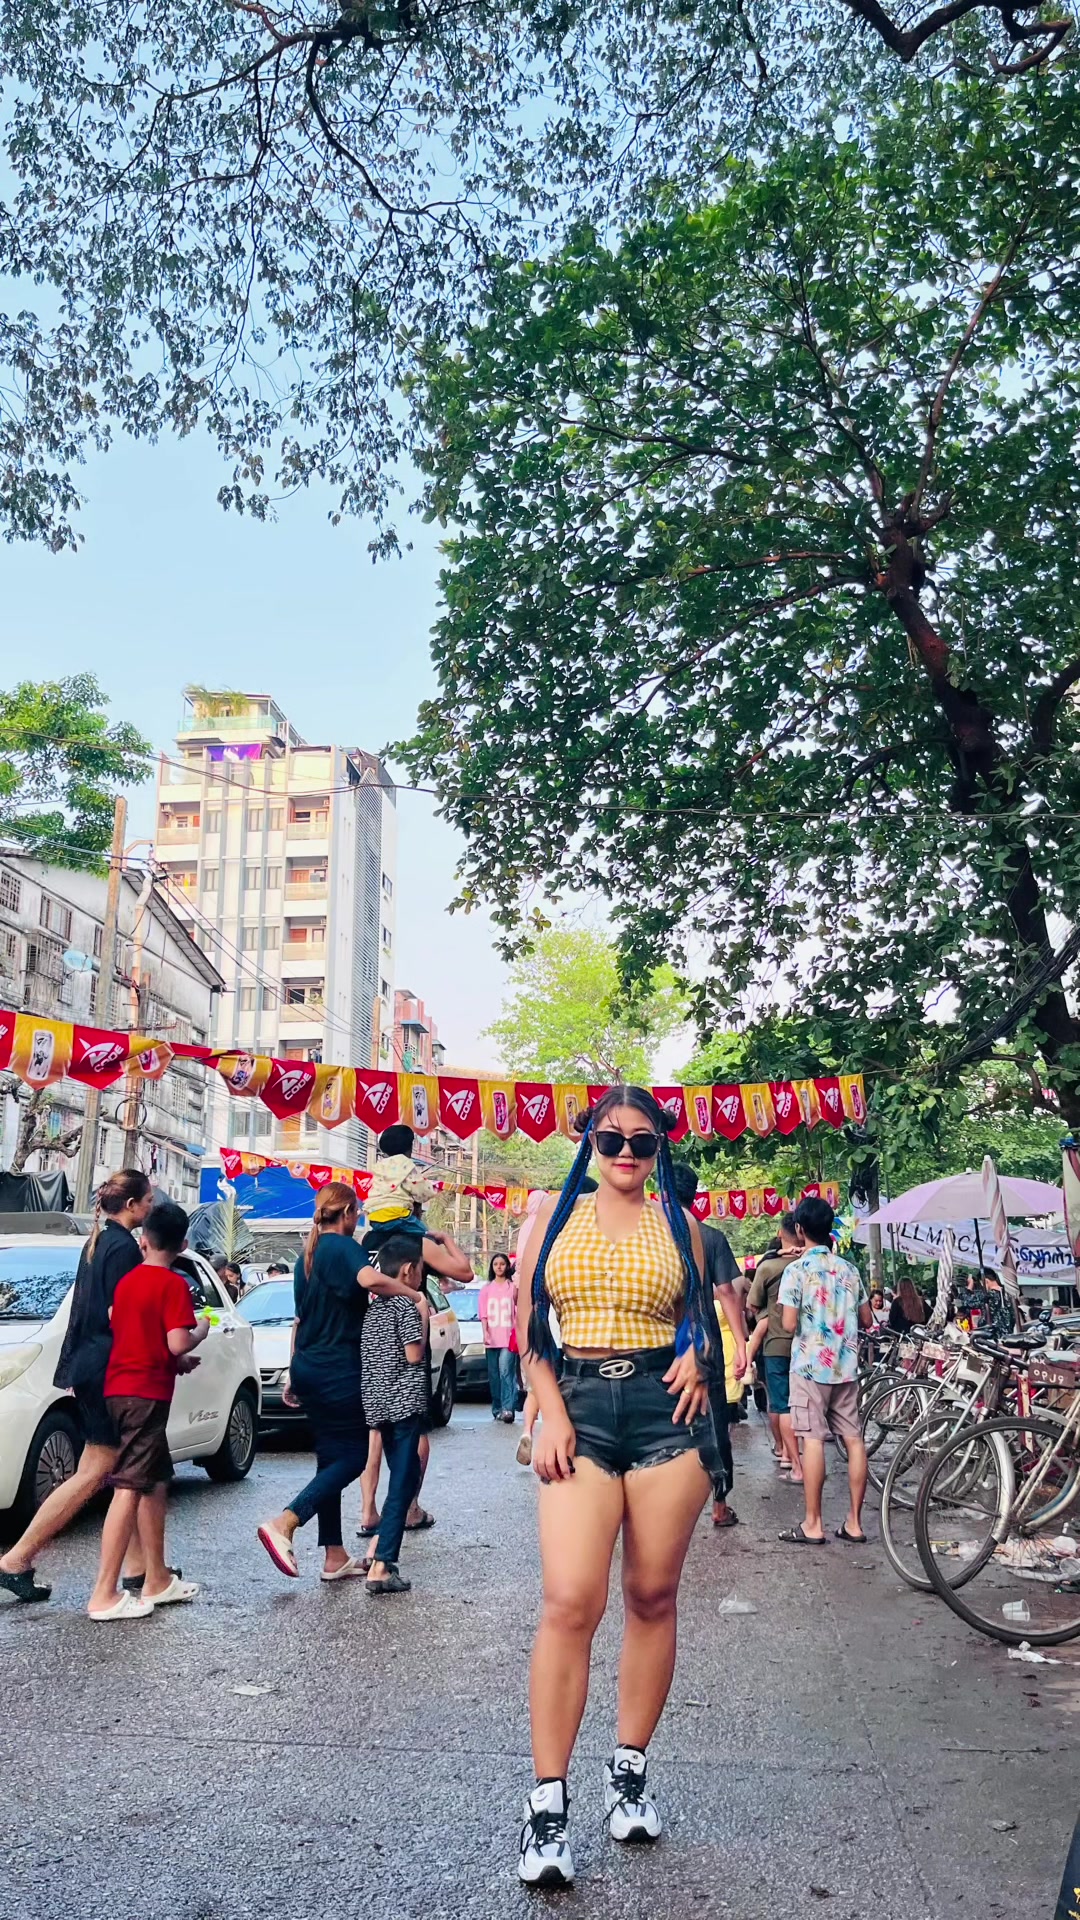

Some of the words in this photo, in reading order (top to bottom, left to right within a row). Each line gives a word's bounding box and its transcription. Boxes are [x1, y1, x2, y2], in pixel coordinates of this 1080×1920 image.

[284, 1072, 312, 1101] CODE
[376, 1083, 394, 1114] CODE
[459, 1090, 476, 1121] CODE
[535, 1095, 551, 1125] CODE
[487, 1297, 512, 1328] 92
